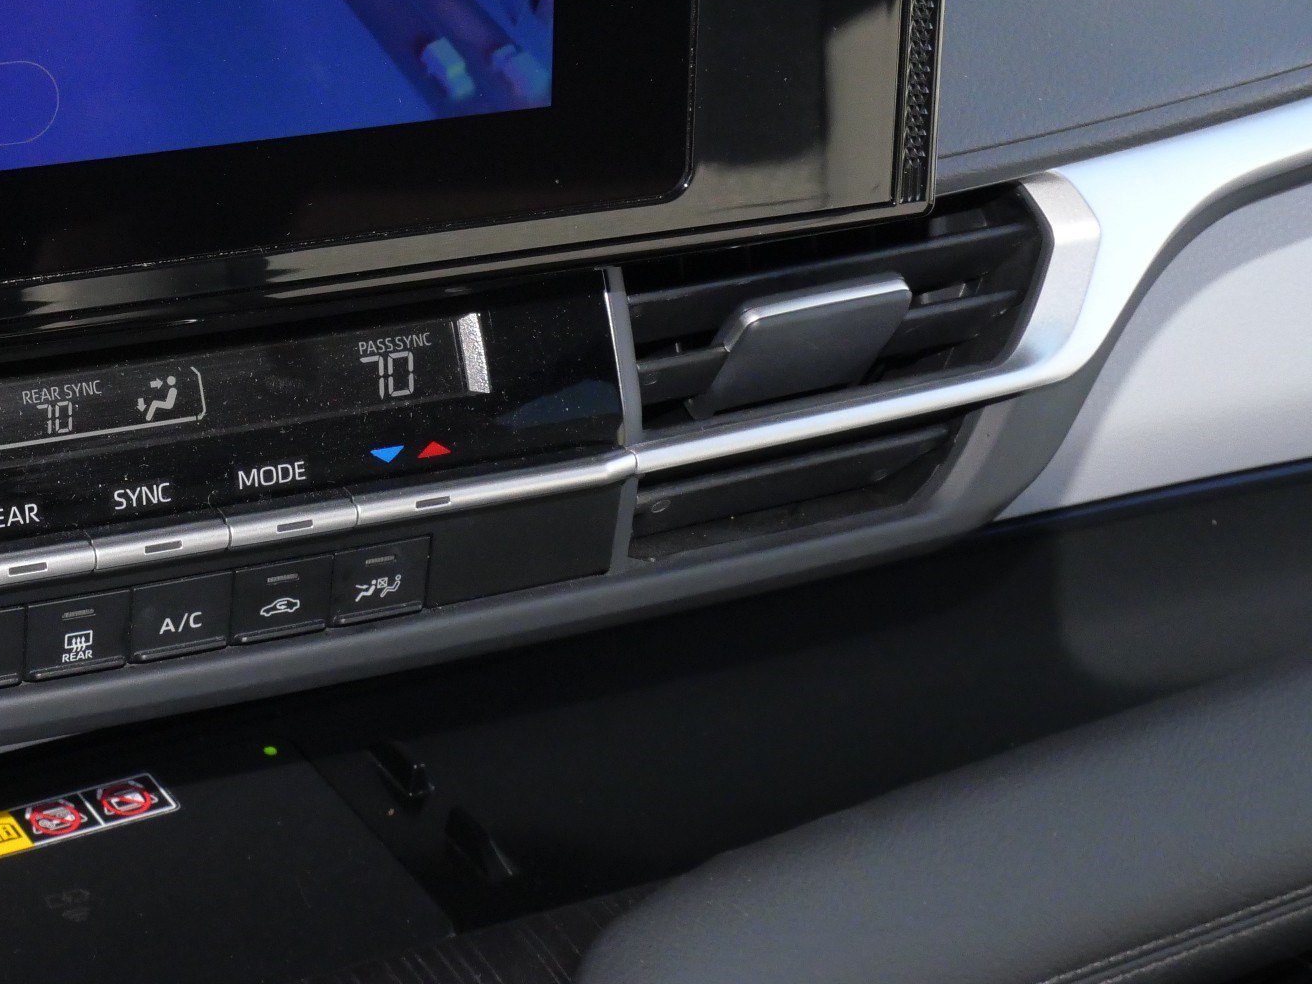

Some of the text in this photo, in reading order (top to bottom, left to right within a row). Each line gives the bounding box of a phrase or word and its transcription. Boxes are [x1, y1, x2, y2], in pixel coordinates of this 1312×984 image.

[358, 332, 432, 355] PASS SYNC
[359, 351, 414, 399] 70
[22, 380, 102, 405] REAR SYNC
[36, 401, 73, 434] 70
[238, 461, 306, 490] MODE
[114, 482, 172, 510] SYNC
[159, 611, 203, 635] A/C
[62, 649, 93, 664] REAR
